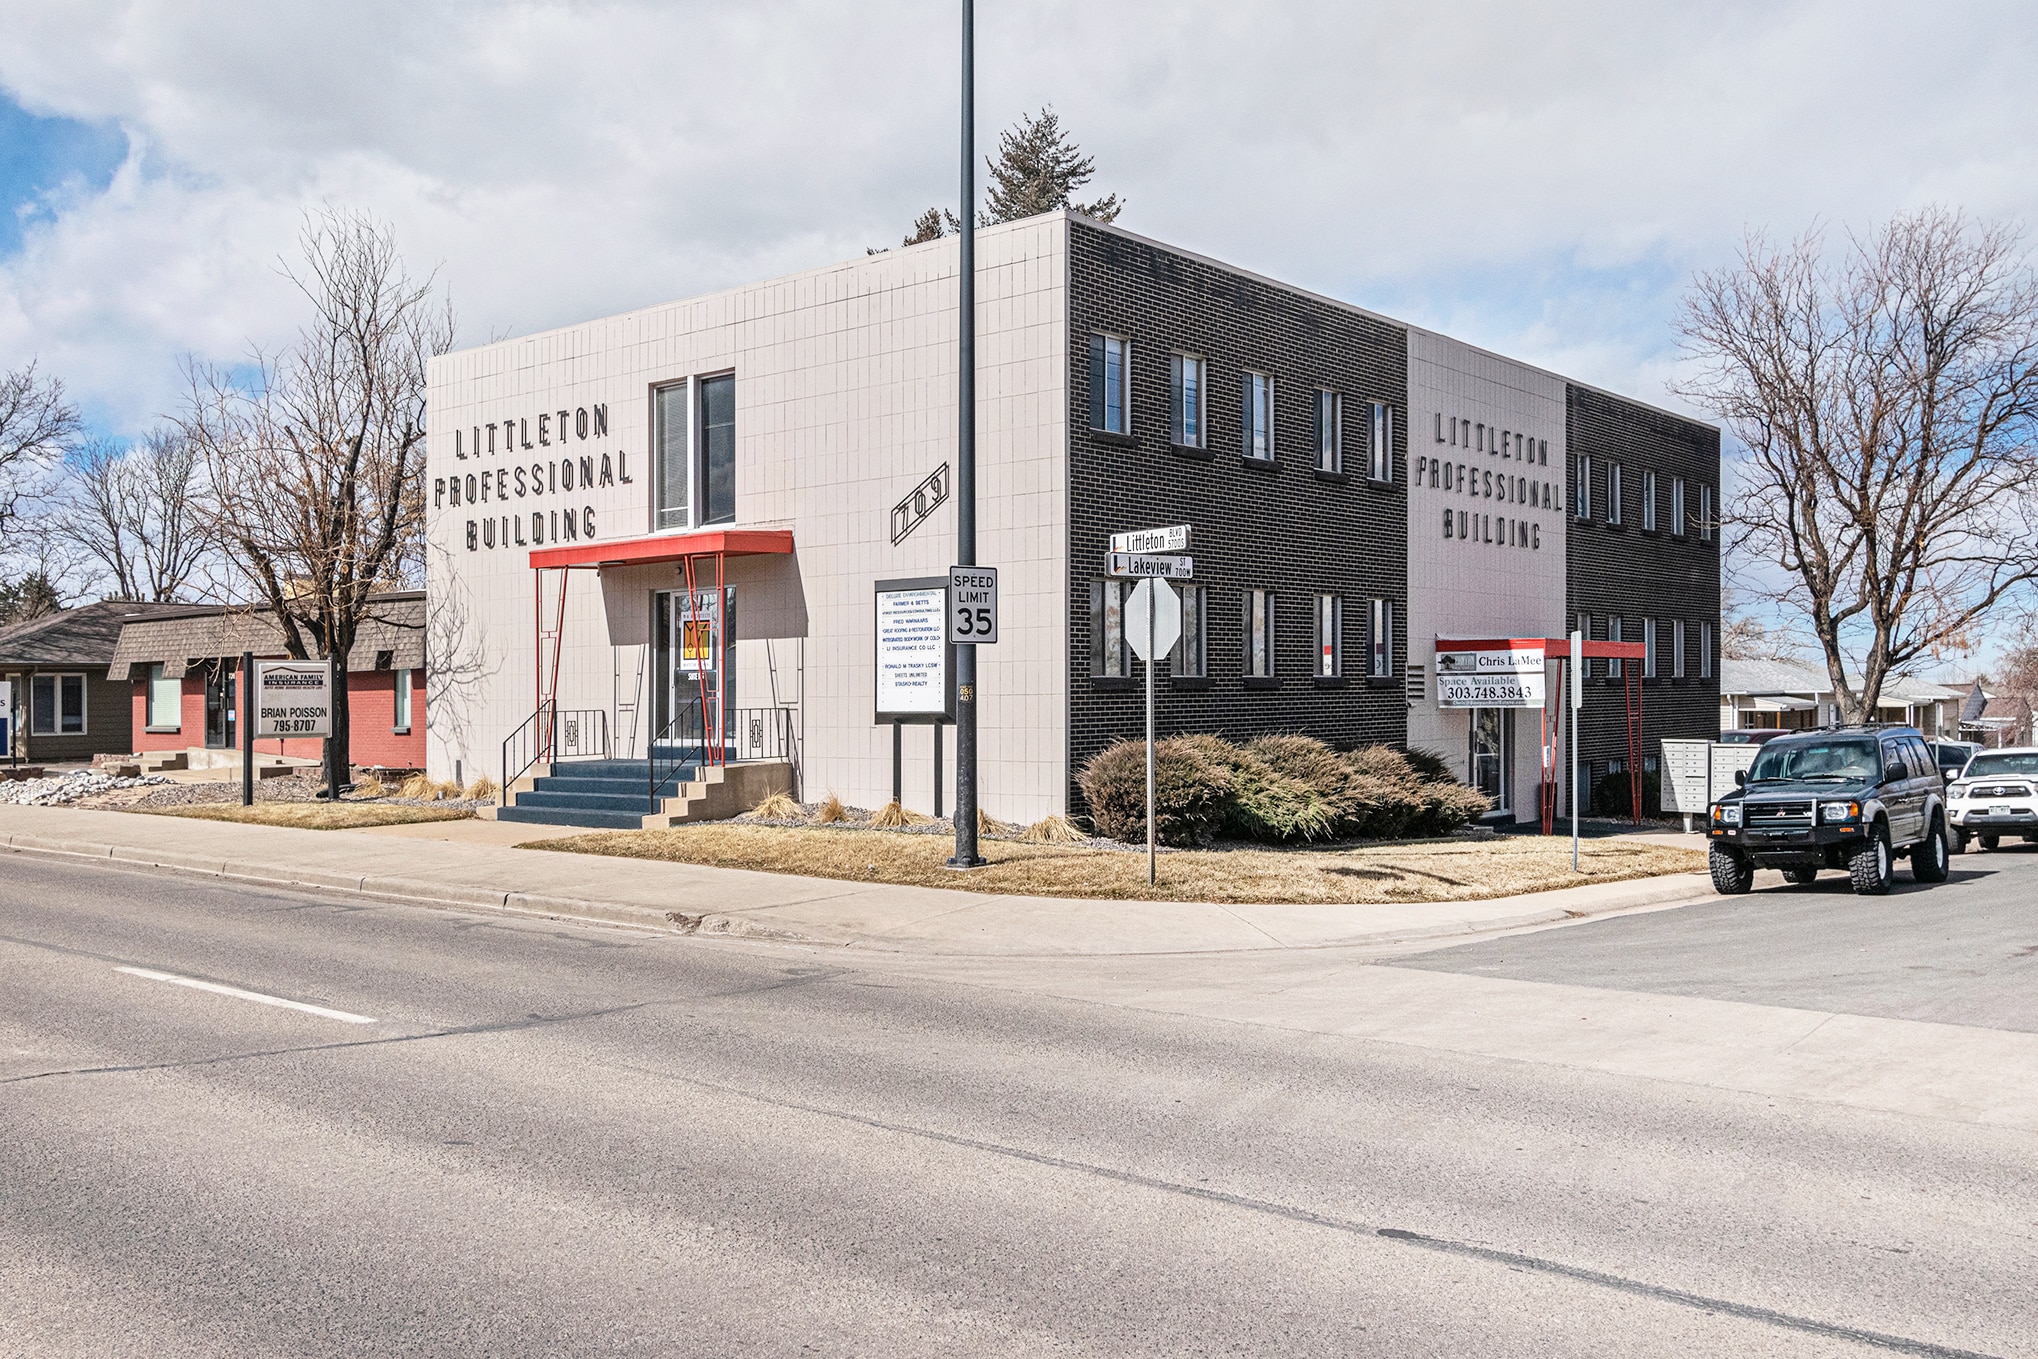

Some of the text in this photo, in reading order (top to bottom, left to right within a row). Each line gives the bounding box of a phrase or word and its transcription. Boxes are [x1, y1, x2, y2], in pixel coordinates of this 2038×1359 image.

[455, 402, 608, 460] LITTLETON
[1435, 412, 1548, 466] LITTLETON
[434, 449, 634, 509] PROFESSIONAL
[1416, 455, 1563, 511] PROFESSIONAL
[896, 475, 943, 532] 709
[466, 505, 596, 552] BUILDING
[1126, 527, 1183, 552] Littleton BLVD
[1444, 508, 1540, 550] BUILDING
[1128, 556, 1186, 575] Lakeview ST
[1175, 567, 1191, 577] 700W
[954, 575, 994, 588] SPEED
[958, 591, 989, 603] LIMIT
[956, 608, 993, 635] 35
[1478, 656, 1505, 667] Chris
[1508, 655, 1542, 666] LaMee
[1439, 676, 1516, 687] Space Available
[1447, 686, 1532, 699] 303.748.3843
[261, 707, 327, 718] BRIAN POISSON
[274, 720, 316, 732] 795-8707
